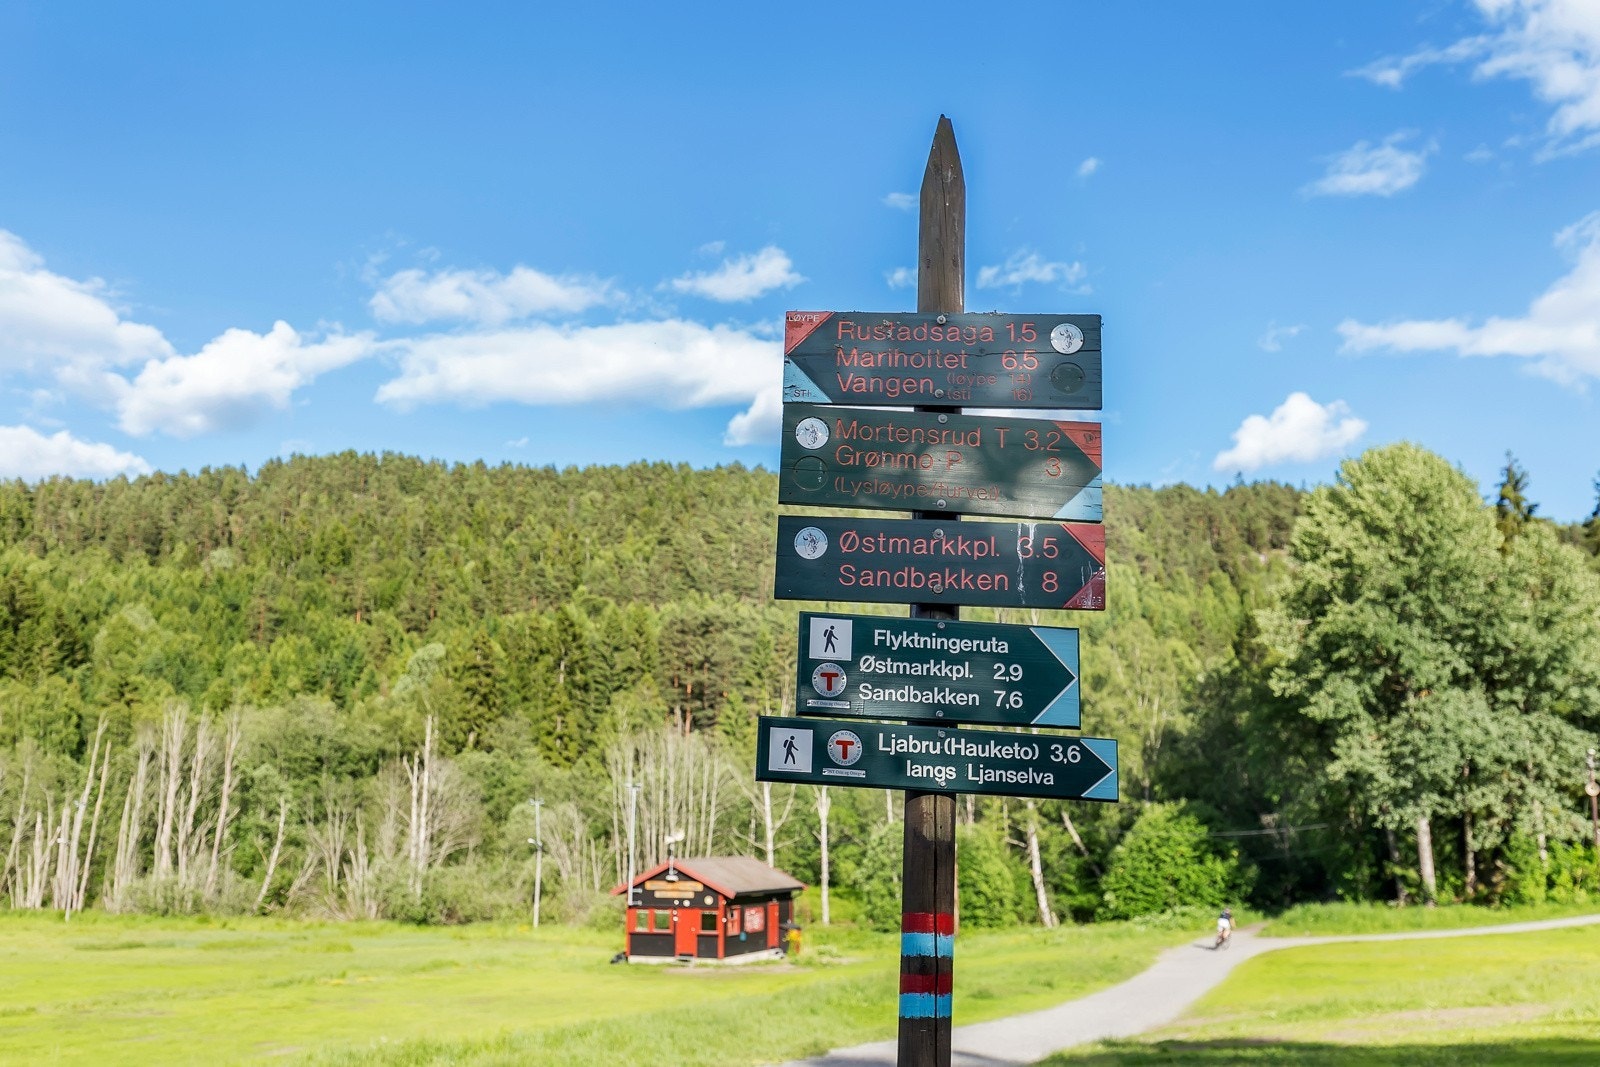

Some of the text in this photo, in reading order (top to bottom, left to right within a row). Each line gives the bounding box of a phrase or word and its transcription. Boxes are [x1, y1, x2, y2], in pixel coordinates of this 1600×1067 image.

[837, 321, 994, 345] Rustadsaga
[836, 347, 968, 370] Mariholtet
[794, 389, 811, 398] STI
[836, 372, 935, 398] Vangen
[835, 418, 981, 448] Mortensrud
[994, 427, 1010, 449] T
[835, 445, 1062, 479] Grønmo P 3
[839, 530, 1000, 560] Østmarkkpl.
[838, 564, 1059, 593] Sandbakken 8
[874, 629, 1009, 654] Flyktningeruta
[859, 655, 1023, 682] Østmarkkpl. 2,9
[820, 672, 839, 691] T
[858, 683, 980, 706] Sandbakken
[993, 690, 1023, 710] 7,6
[835, 740, 855, 760] T
[1050, 744, 1081, 764] 3,6
[906, 760, 1054, 785] langs Ljanselva
